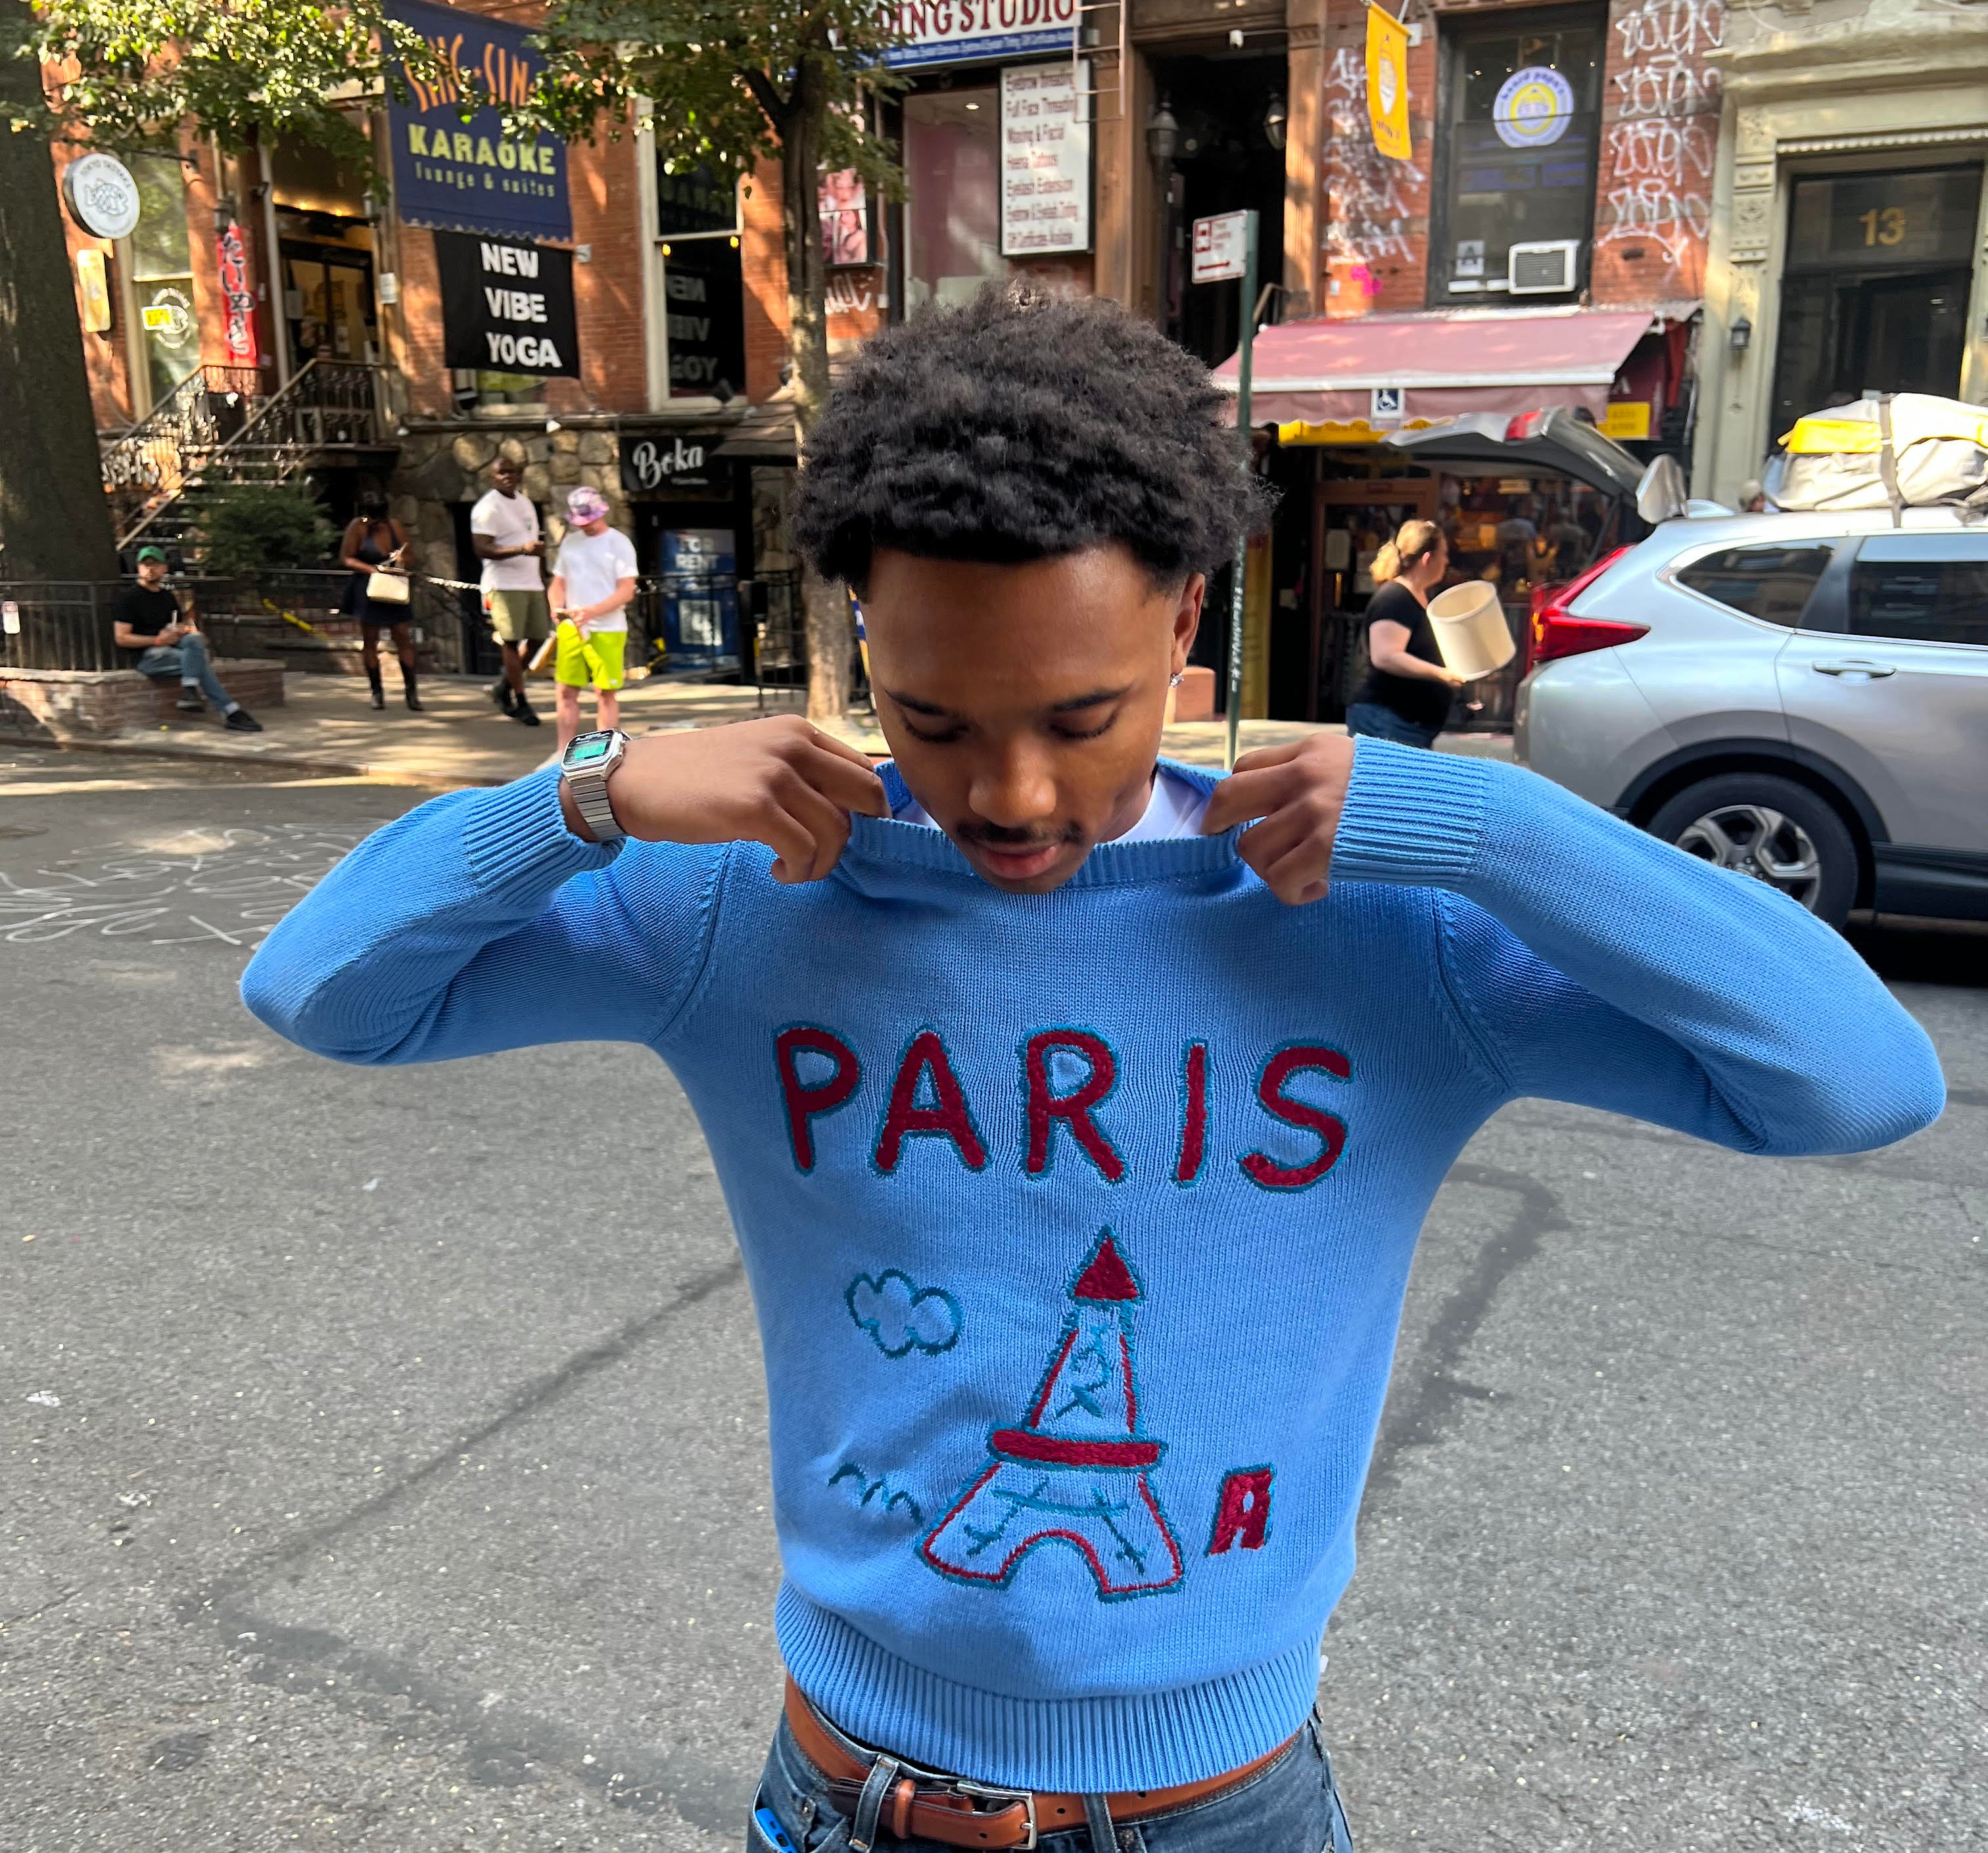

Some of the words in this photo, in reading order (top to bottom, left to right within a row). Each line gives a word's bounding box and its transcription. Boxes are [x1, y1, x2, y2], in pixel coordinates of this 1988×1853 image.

[960, 0, 1074, 32] STUDIO
[408, 123, 557, 176] KARAOKE
[415, 162, 475, 190] lounge
[483, 172, 494, 190] &
[502, 178, 556, 197] suites
[1858, 207, 1905, 246] 13
[480, 241, 539, 279] NEW
[484, 286, 548, 323] VIBE
[485, 331, 563, 368] YOGA
[774, 1021, 1356, 1192] PARIS
